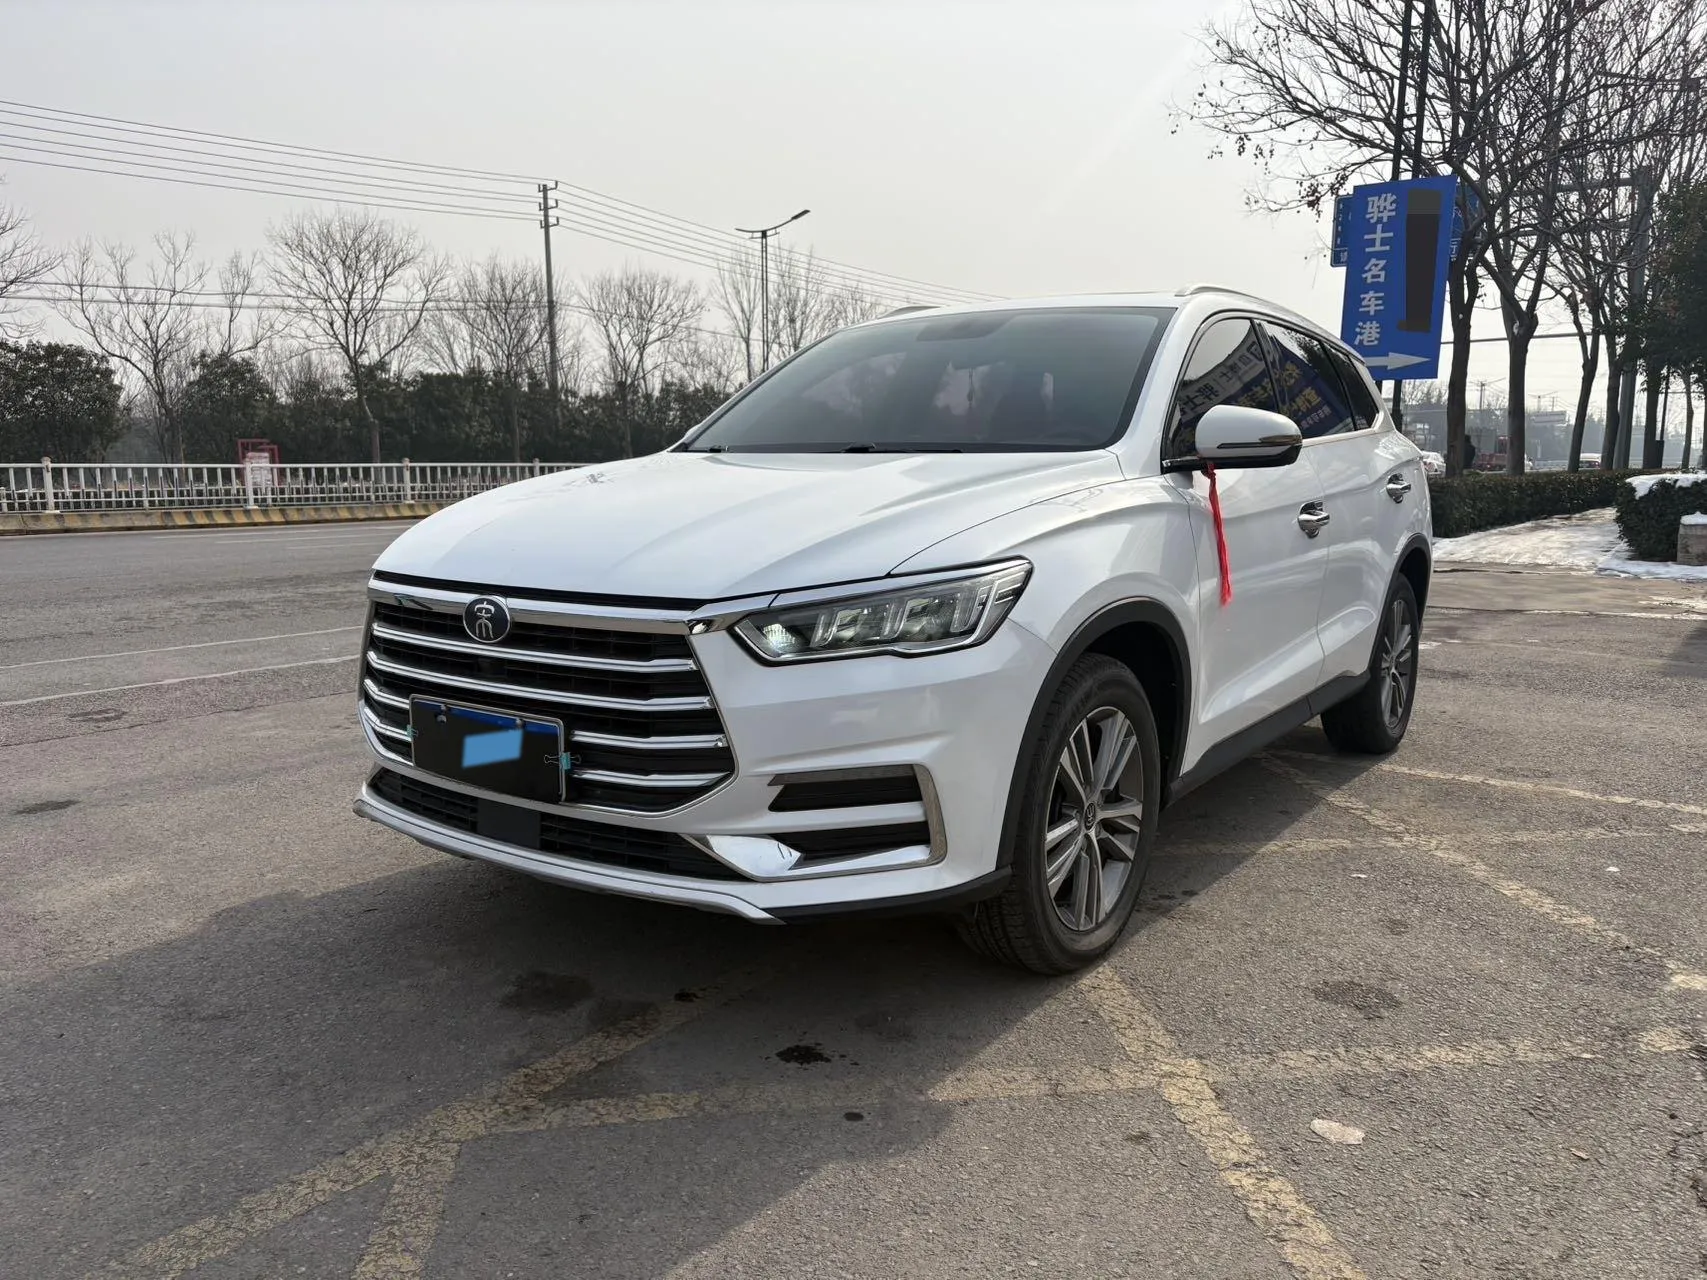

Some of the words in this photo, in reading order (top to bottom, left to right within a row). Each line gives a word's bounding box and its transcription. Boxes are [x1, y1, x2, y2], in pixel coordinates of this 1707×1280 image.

[1354, 193, 1397, 346] 骅士名车港
